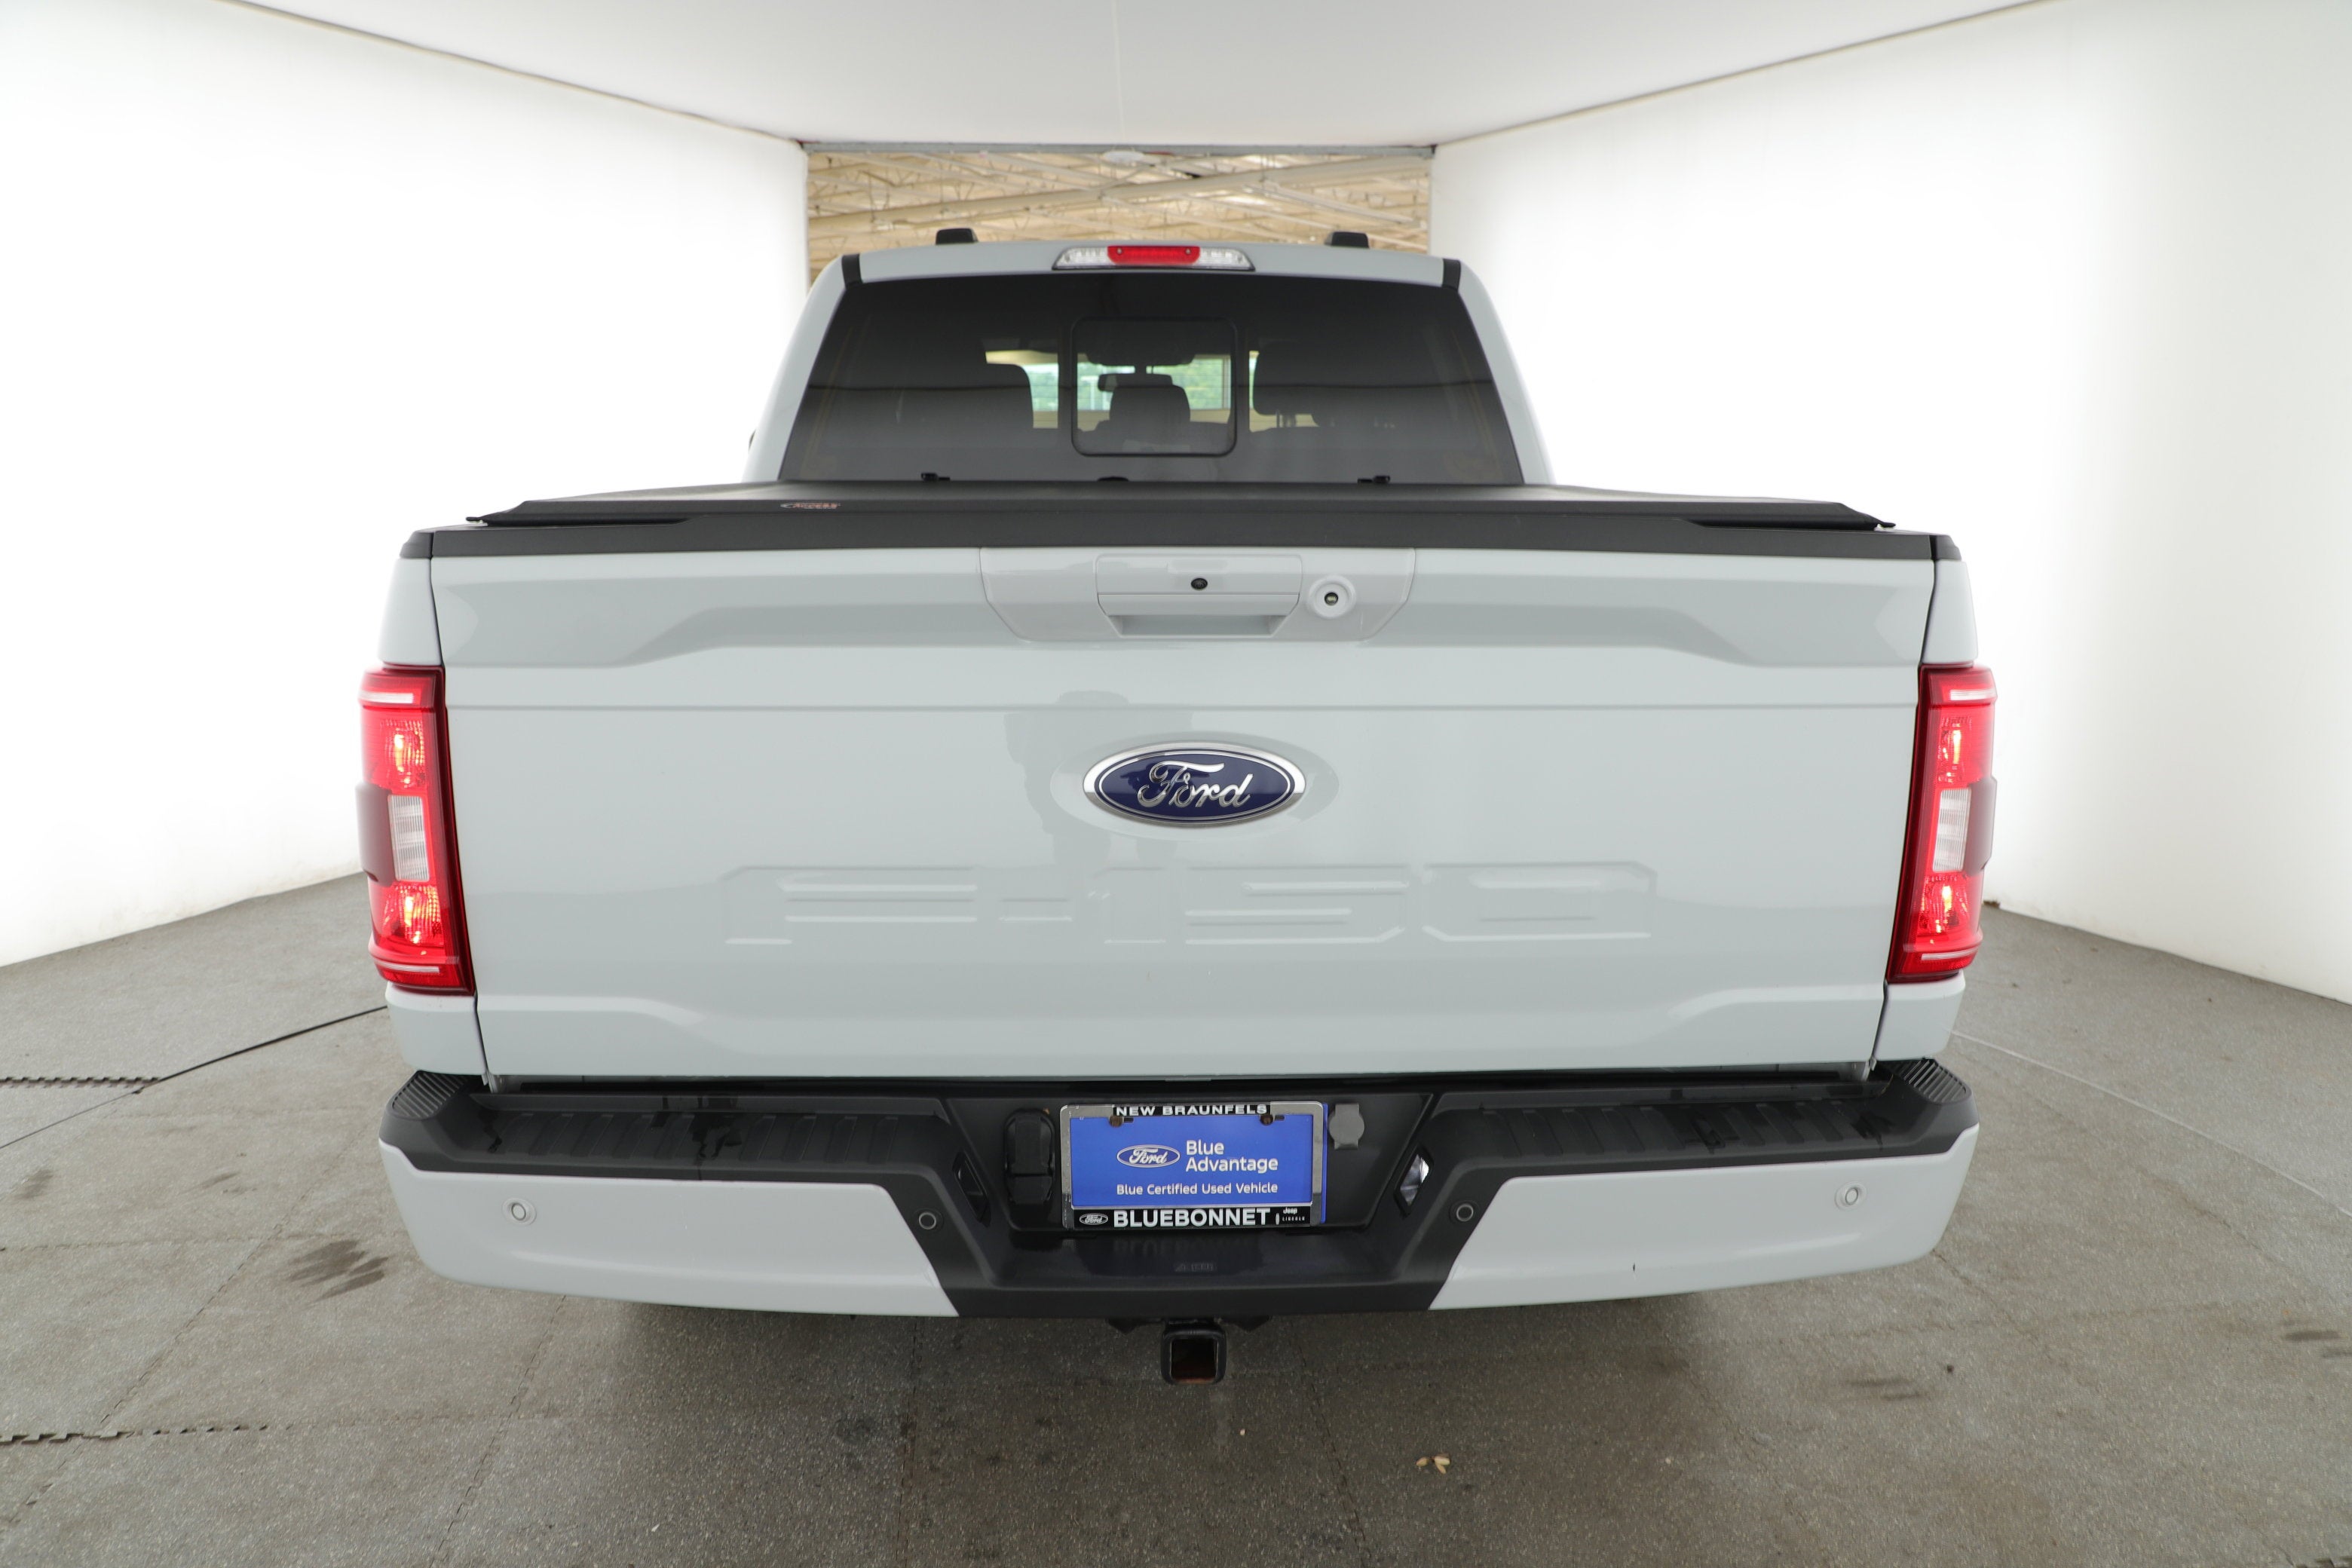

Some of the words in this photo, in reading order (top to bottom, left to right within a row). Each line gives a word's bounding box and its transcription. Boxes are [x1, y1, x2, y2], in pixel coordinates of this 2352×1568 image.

[1137, 760, 1253, 808] Ford
[1116, 1105, 1156, 1116] NEW
[1162, 1104, 1267, 1116] BRAUNFELS
[1129, 1147, 1168, 1165] Ford
[1186, 1139, 1225, 1155] Blue
[1186, 1156, 1279, 1174] Advantage
[1116, 1184, 1144, 1195] Blue
[1147, 1183, 1198, 1195] Certified
[1202, 1182, 1232, 1194] Used
[1236, 1181, 1279, 1193] Vehicle
[1113, 1207, 1271, 1228] BLUEBONNET
